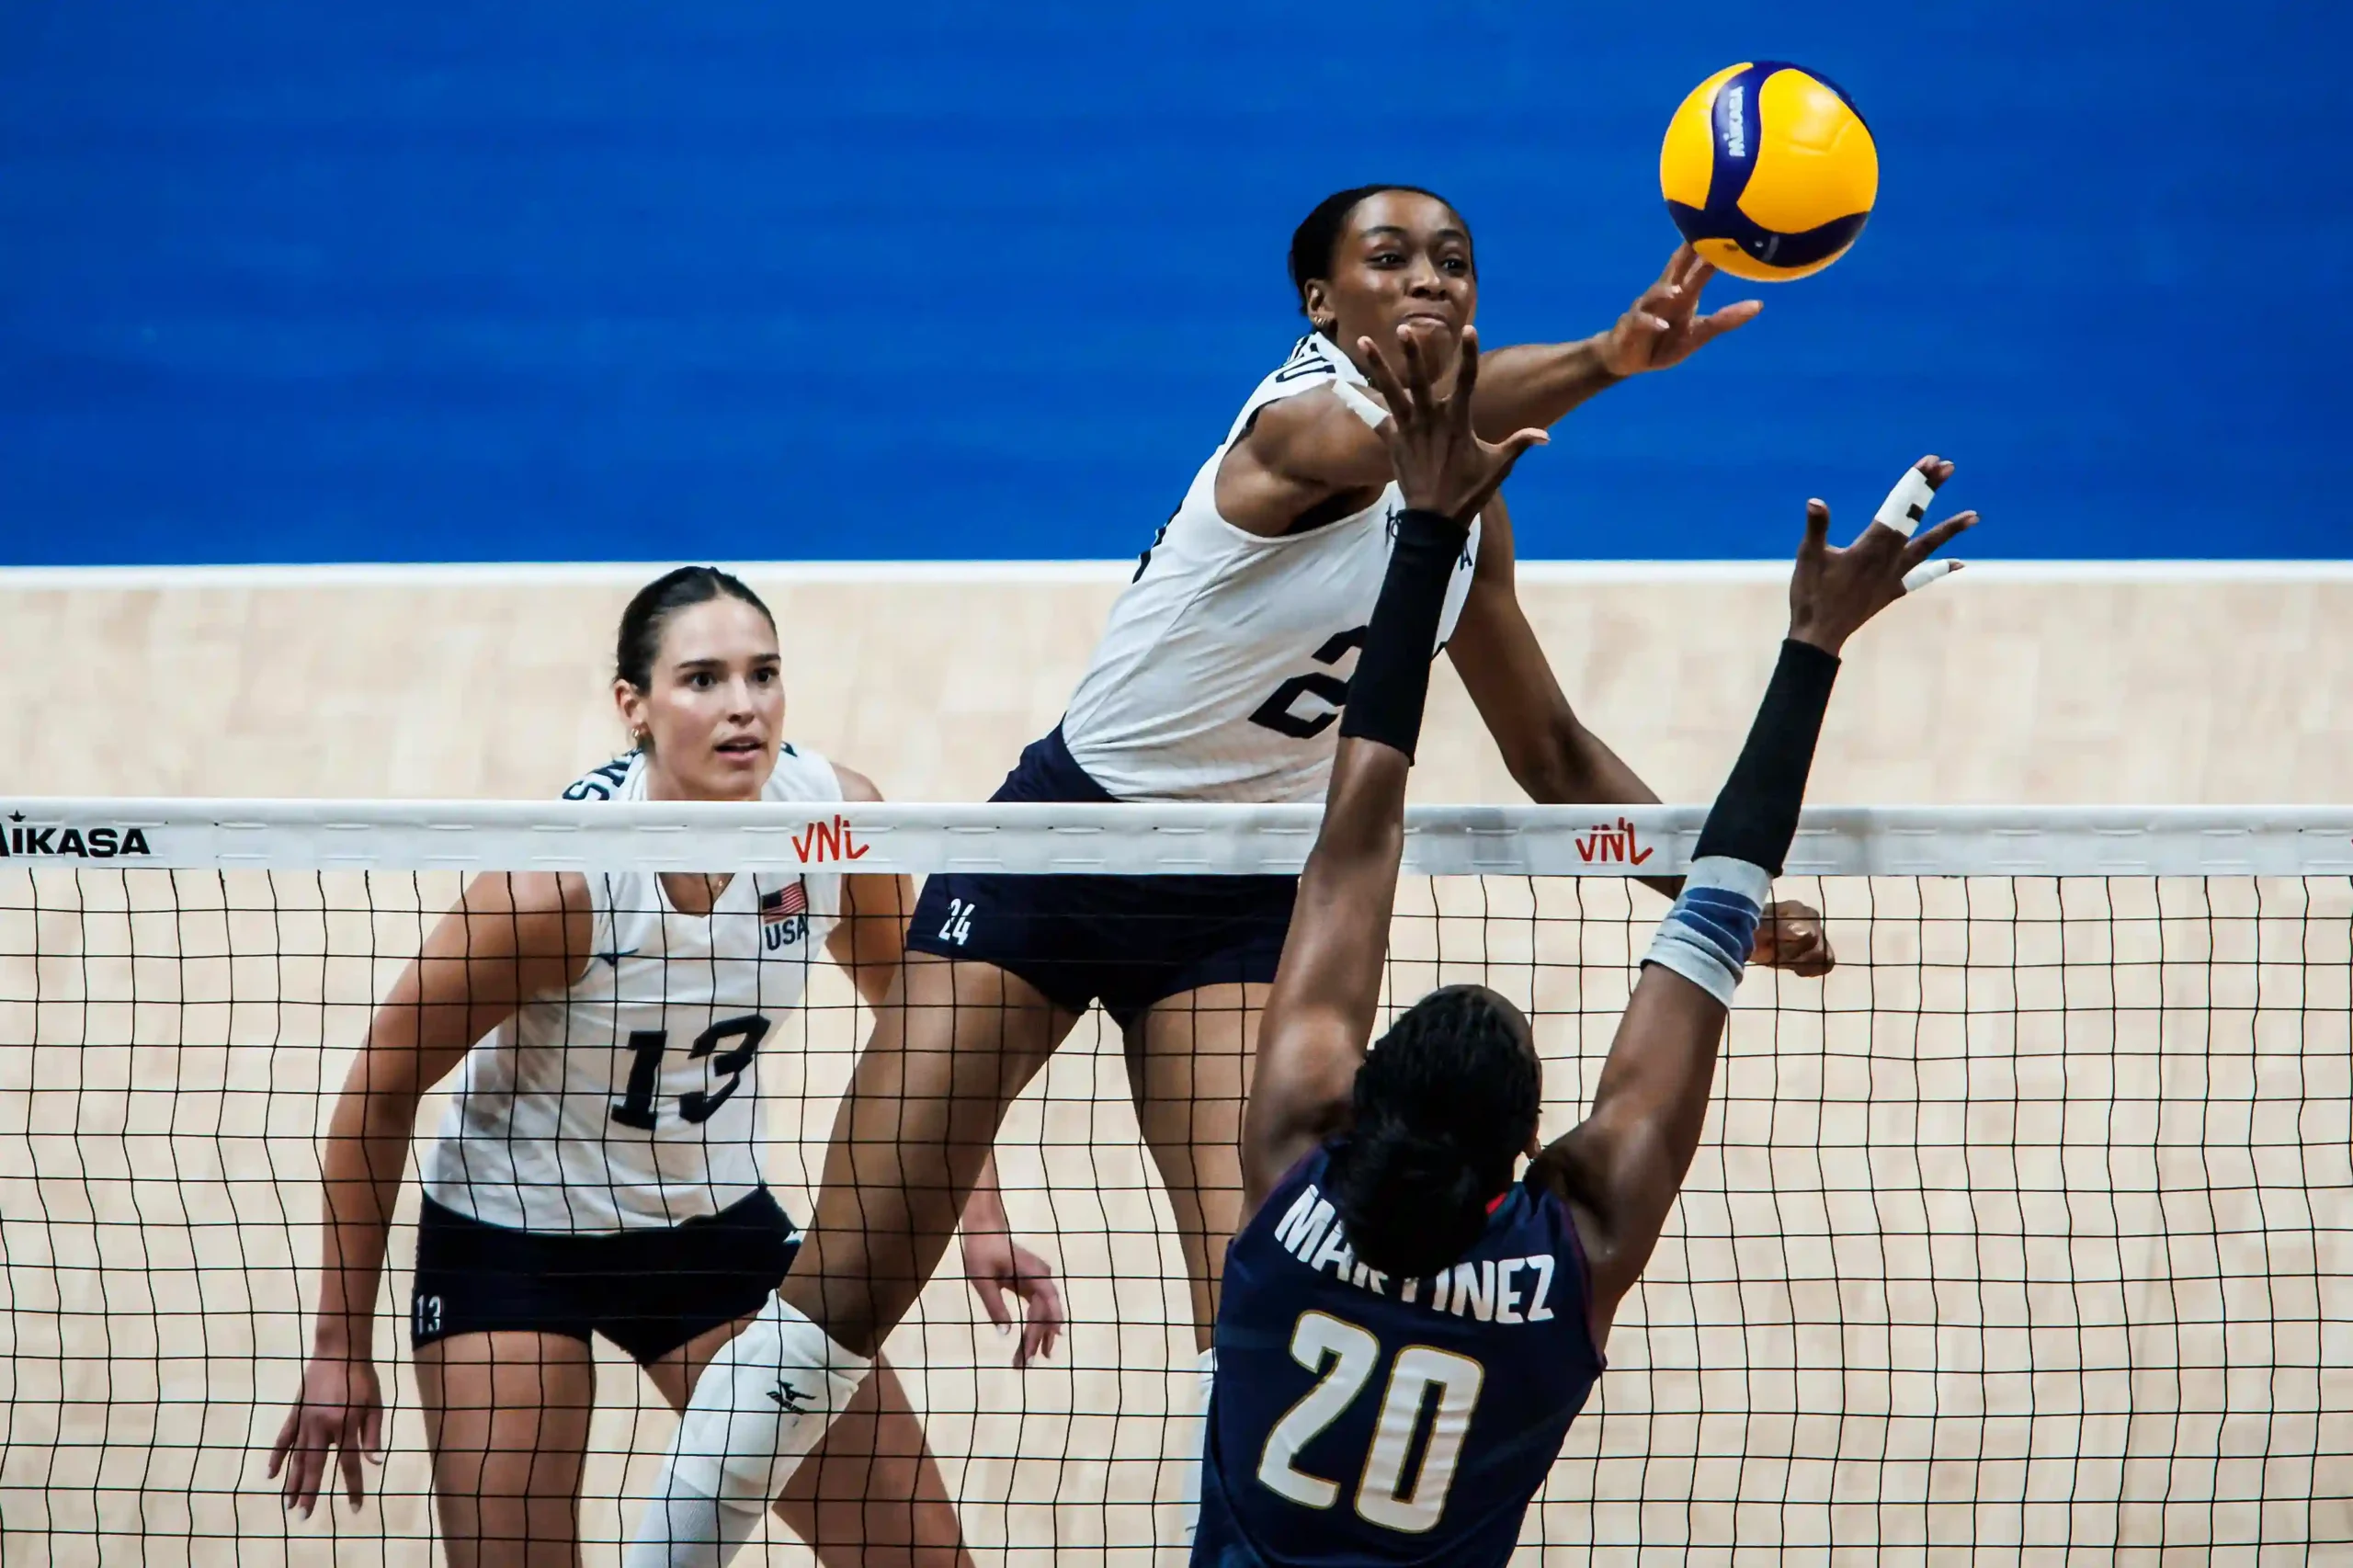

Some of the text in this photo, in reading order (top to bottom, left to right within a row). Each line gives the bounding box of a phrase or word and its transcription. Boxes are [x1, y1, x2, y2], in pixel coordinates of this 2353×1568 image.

[1248, 625, 1448, 739] 2
[0, 810, 151, 858] IKASA
[791, 814, 870, 863] VNL
[1574, 816, 1654, 866] VNL
[765, 913, 810, 951] USA
[938, 898, 975, 946] 24
[610, 1014, 772, 1131] 13
[416, 1294, 441, 1335] 13
[1256, 1309, 1485, 1534] 20
